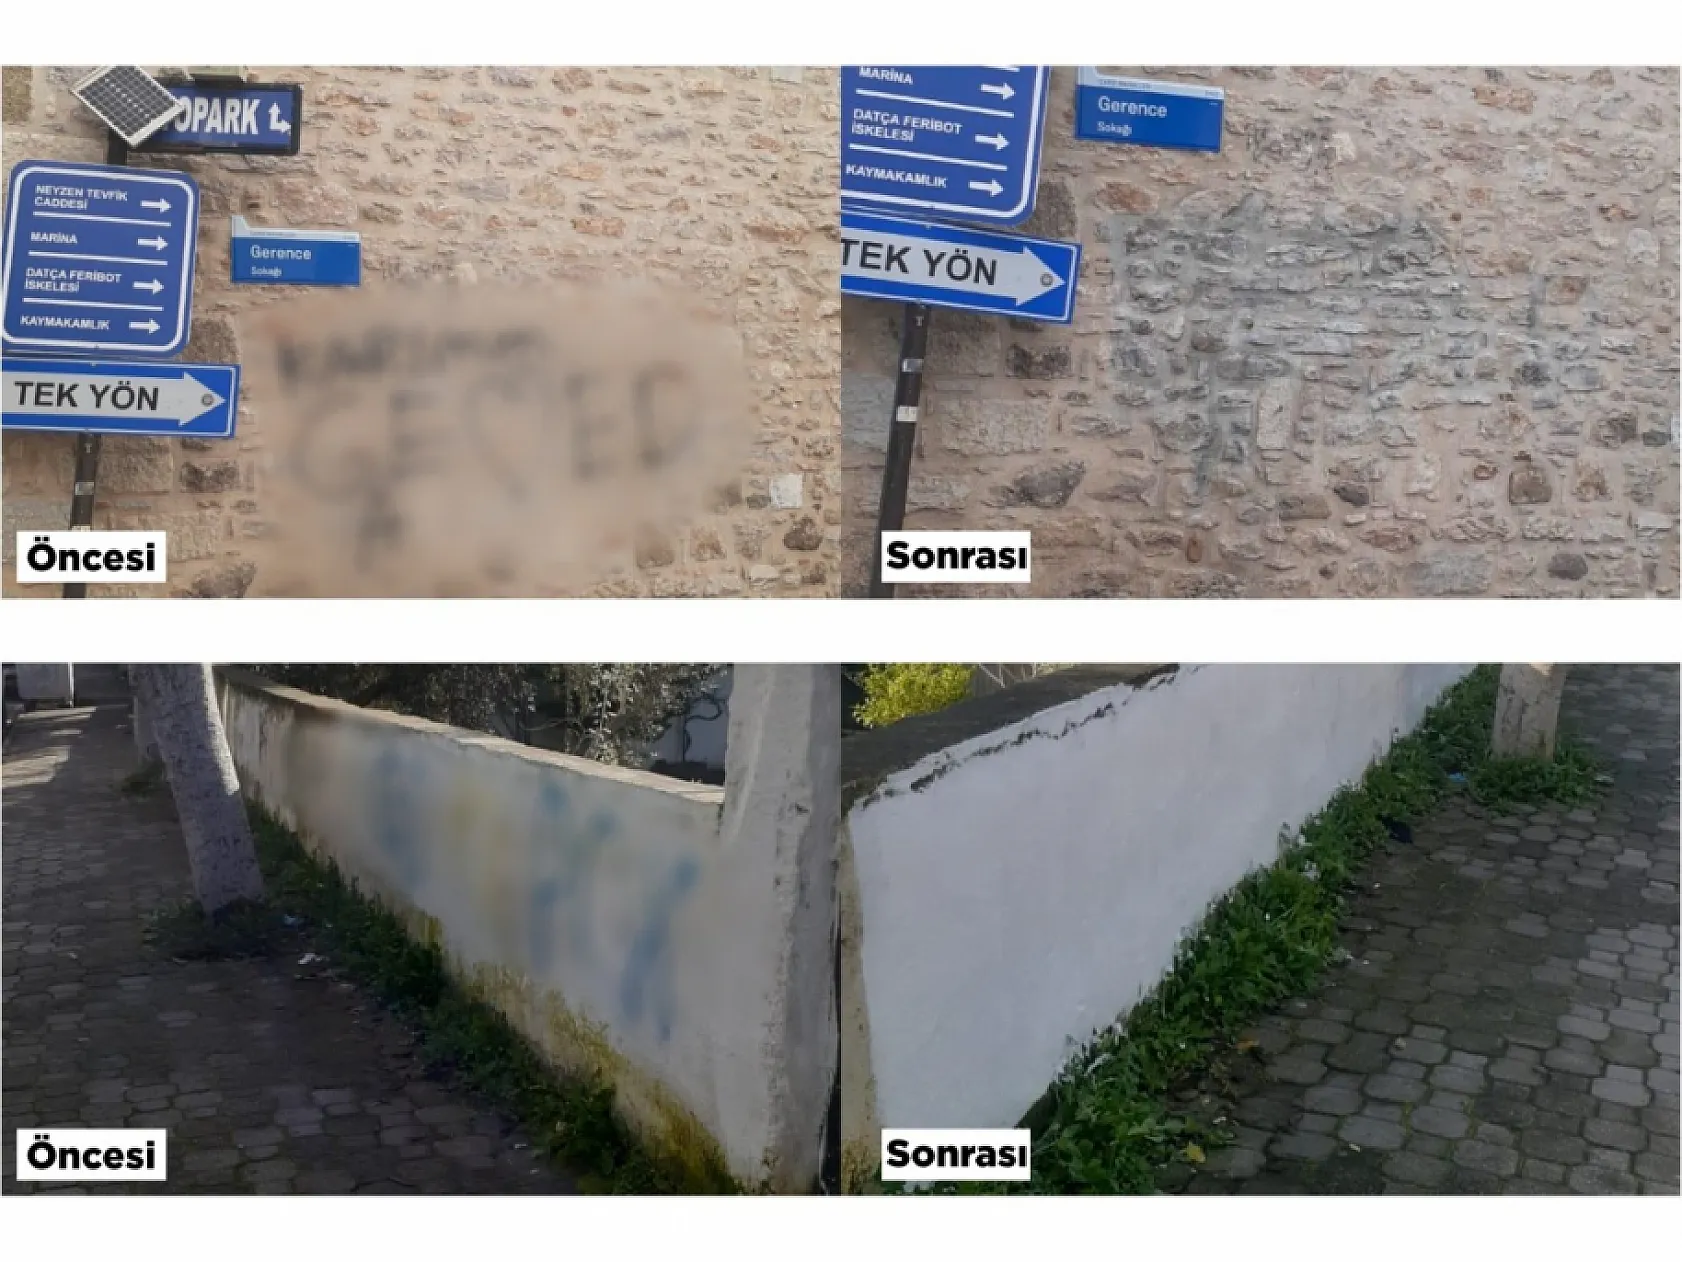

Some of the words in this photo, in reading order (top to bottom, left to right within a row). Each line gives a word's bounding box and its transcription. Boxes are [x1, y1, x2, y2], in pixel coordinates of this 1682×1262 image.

[859, 66, 914, 85] MARİNA
[164, 96, 260, 135] OPARK
[1098, 95, 1168, 118] Gerence
[853, 108, 900, 125] DATÇA
[903, 115, 963, 135] FERİBOT
[851, 121, 915, 142] İSKELESİ
[845, 164, 948, 188] KAYMAKAMLIK
[36, 184, 83, 197] NEYZEN
[86, 188, 128, 201] TEVFİK
[34, 196, 88, 210] CADDESİ
[30, 232, 78, 244] MARİNA
[250, 244, 312, 260] Gerence
[841, 238, 911, 274] TEK
[923, 248, 997, 286] YÖN
[26, 267, 67, 280] DATÇA
[69, 269, 122, 283] FERİBOT
[24, 278, 80, 293] İSKELESİ
[20, 315, 110, 331] KAYMAKAMLIK
[14, 381, 79, 408] TEK
[89, 380, 159, 411] YÖN
